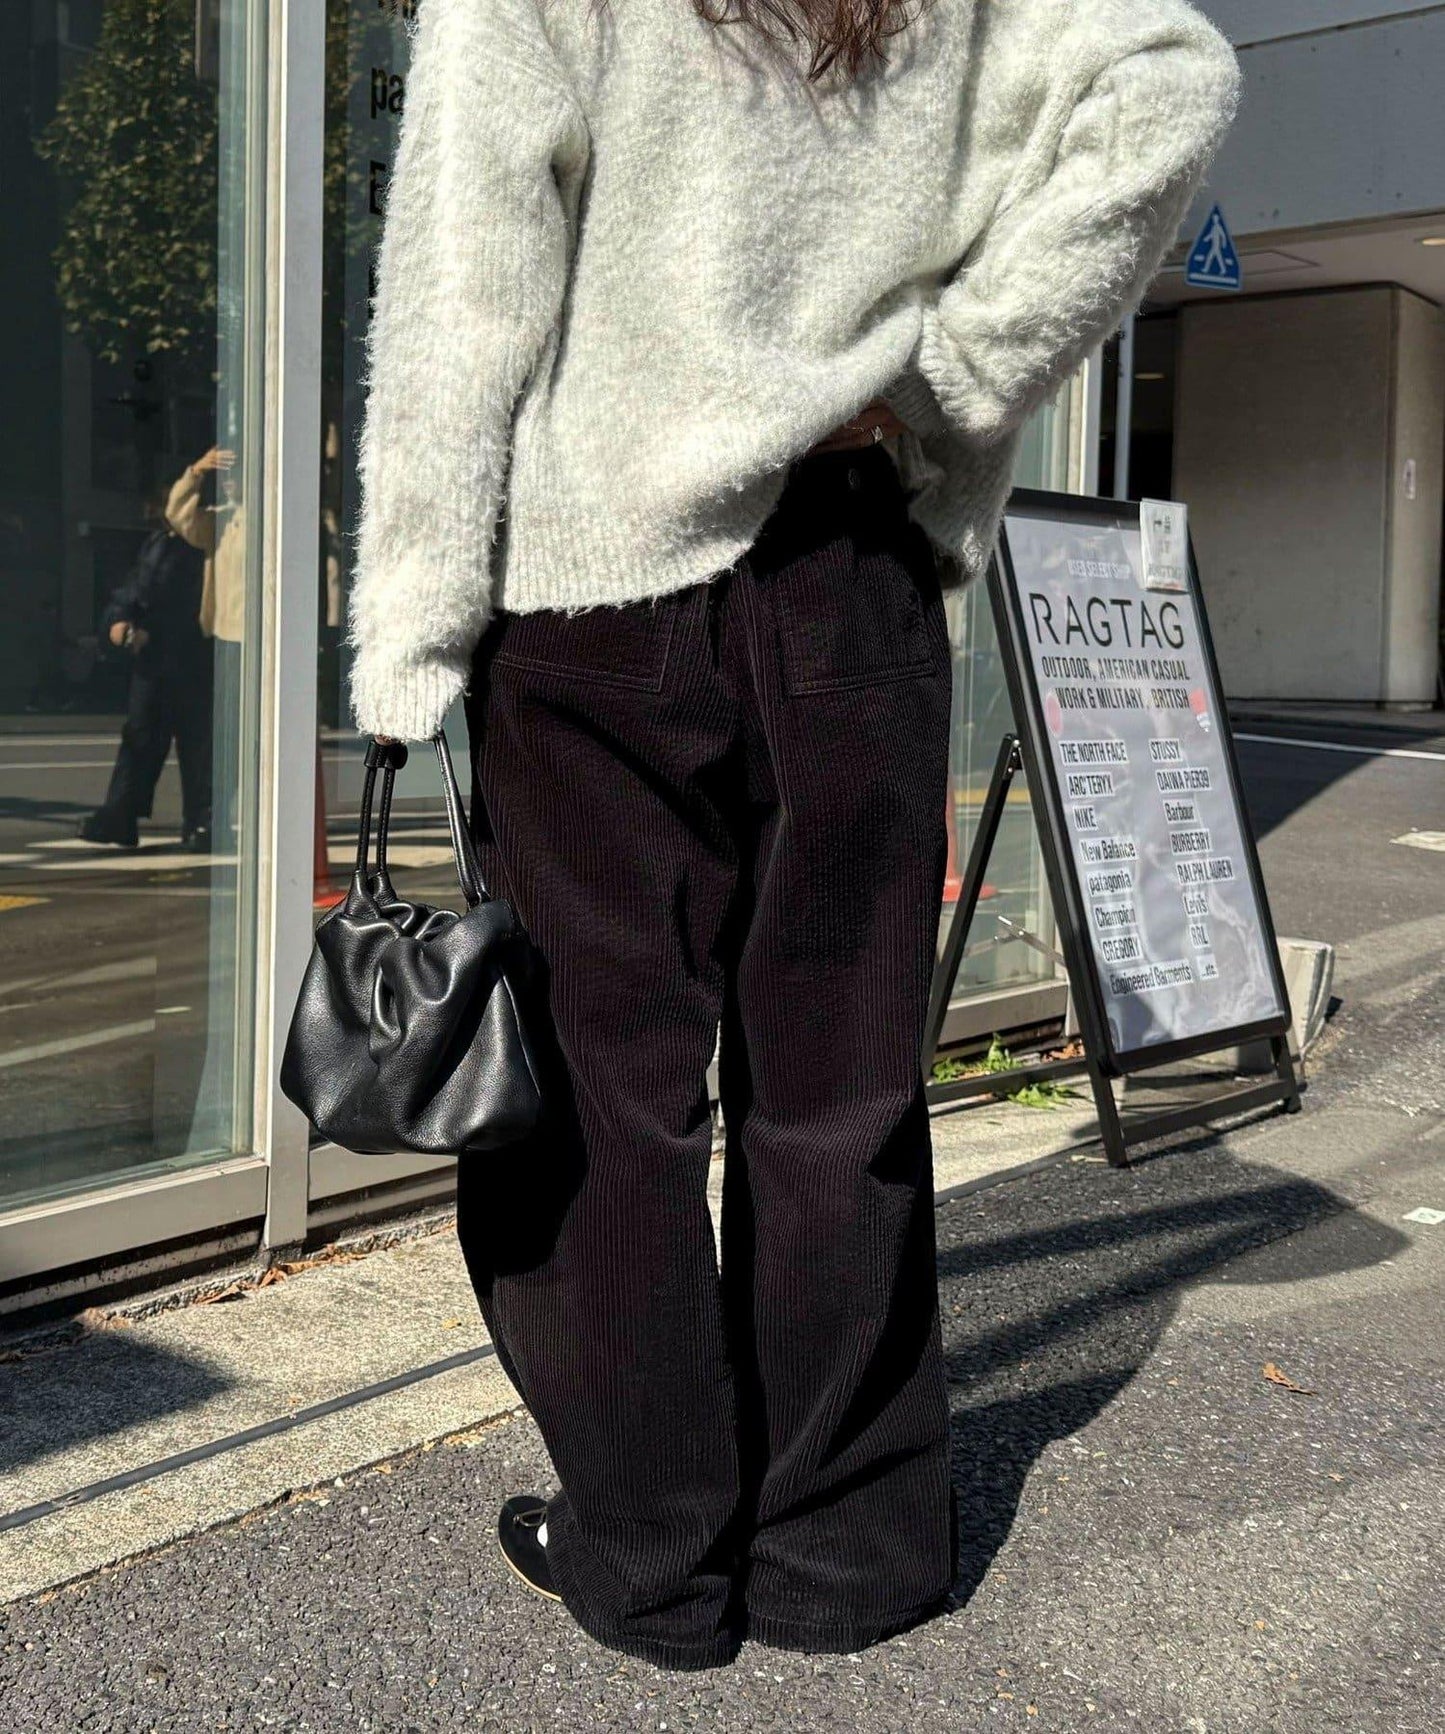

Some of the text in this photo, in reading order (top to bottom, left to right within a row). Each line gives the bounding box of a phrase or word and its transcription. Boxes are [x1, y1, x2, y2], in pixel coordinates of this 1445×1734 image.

[1029, 593, 1185, 650] RAGTAG
[1041, 656, 1190, 682] OUTDOOR, AMERICAN CASUAL
[1055, 687, 1090, 709] WORK
[1088, 688, 1096, 709] &
[1150, 687, 1190, 709] BRITISH
[1060, 741, 1128, 763] THE NORTH FACE
[1156, 769, 1210, 791] DAIWA PIER39
[1073, 806, 1097, 828] NIKE
[1164, 801, 1195, 822] Barbour
[1080, 838, 1136, 861] New Balance
[1170, 832, 1211, 853] BURBERRY
[1089, 870, 1132, 895] patagonia
[1177, 863, 1204, 883] RALPH
[1095, 904, 1137, 928] Champion
[1102, 936, 1141, 961] GREGORY
[1110, 962, 1192, 995] Engineered Garments
